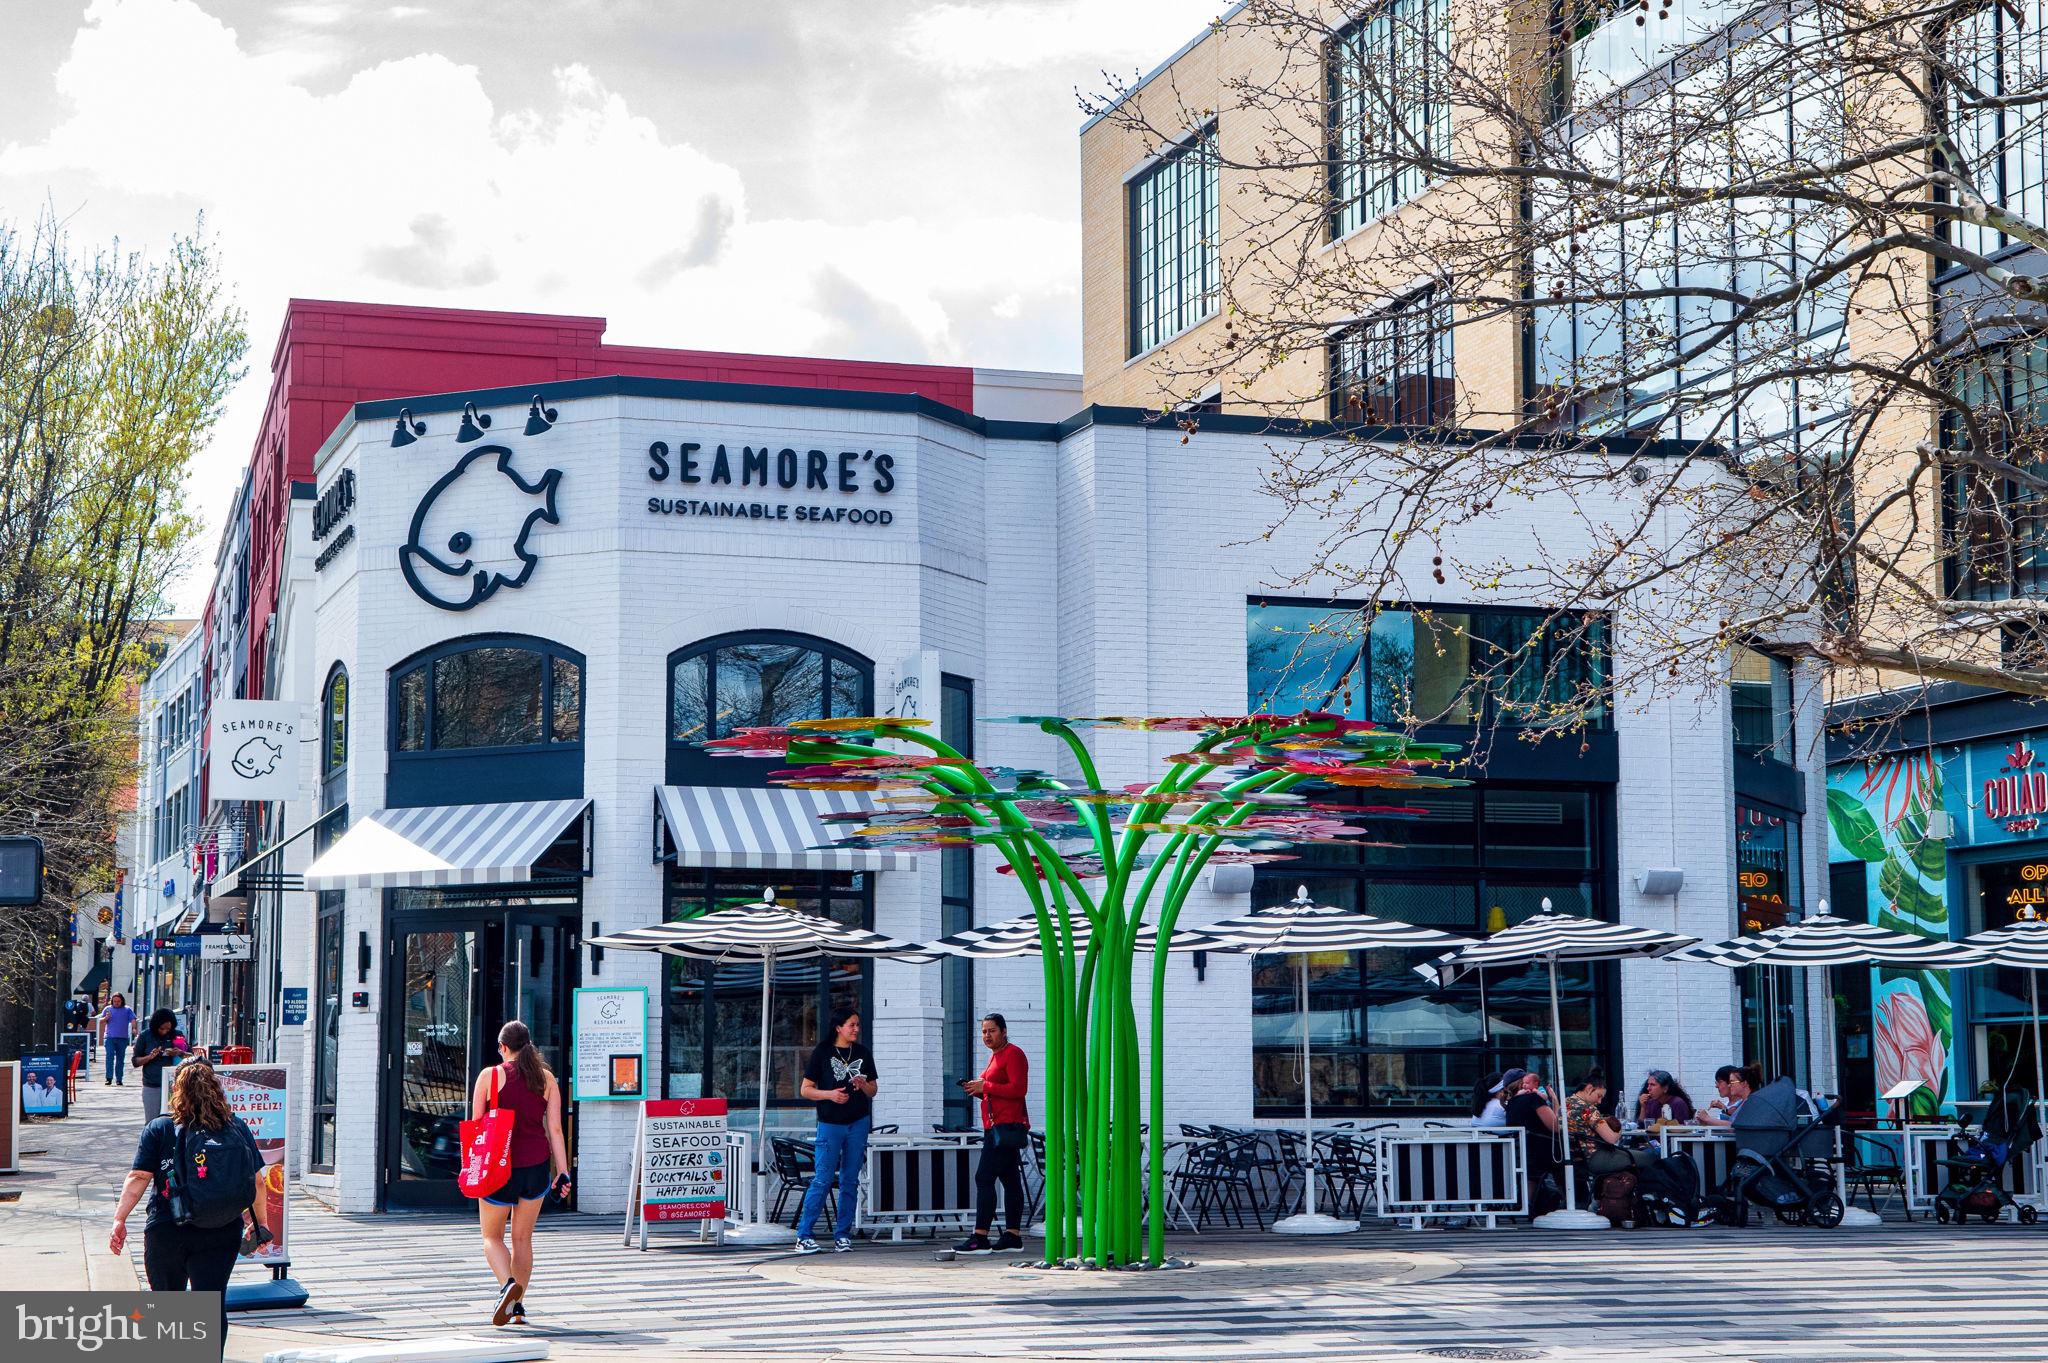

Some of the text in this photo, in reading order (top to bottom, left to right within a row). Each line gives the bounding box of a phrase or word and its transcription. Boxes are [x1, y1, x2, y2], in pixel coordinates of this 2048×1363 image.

[648, 441, 895, 494] SEAMORE'S
[647, 498, 893, 525] SUSTAINABLE SEAFOOD
[222, 719, 294, 735] SEAMORE'S
[2009, 888, 2045, 904] ALL
[231, 1093, 270, 1102] US FOR
[250, 1102, 282, 1111] FELIZ!
[652, 1119, 722, 1131] SUSTAINABLE
[652, 1135, 721, 1149] SEAFOOD
[651, 1152, 704, 1167] OYSTERS
[649, 1170, 708, 1184] COCKTAILS
[656, 1185, 716, 1197] HAPPY HOUR
[658, 1202, 711, 1210] SEAMORES.COM
[670, 1210, 711, 1218] @SEAMORES
